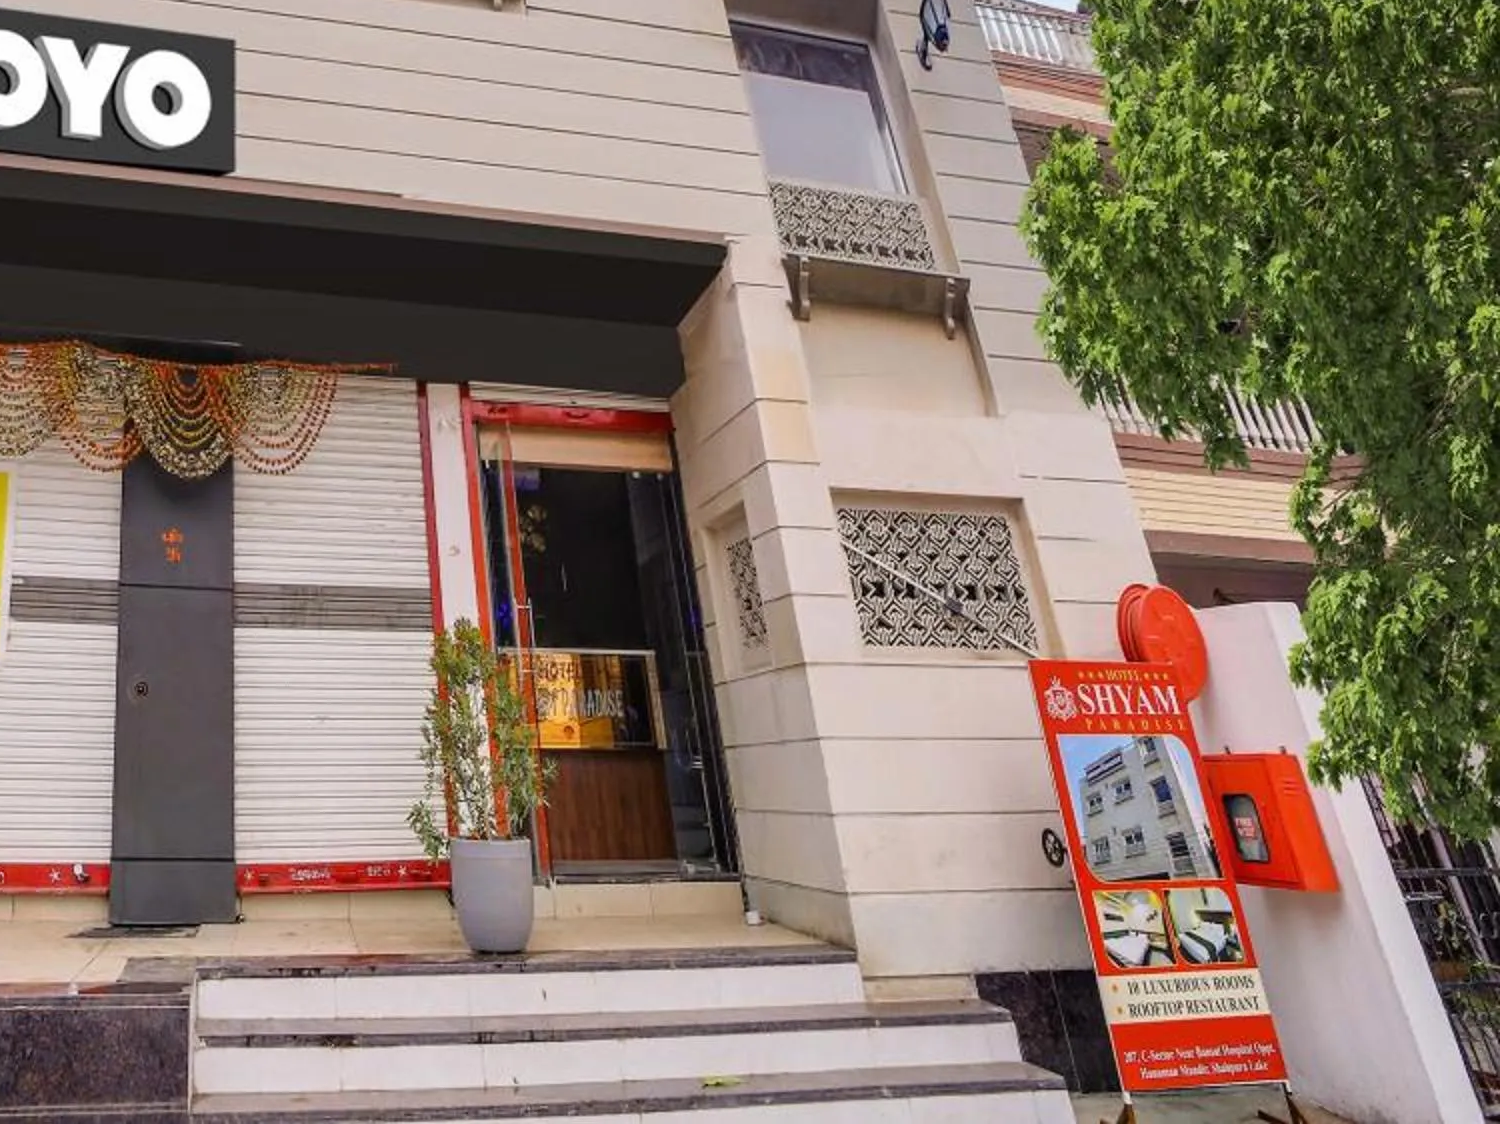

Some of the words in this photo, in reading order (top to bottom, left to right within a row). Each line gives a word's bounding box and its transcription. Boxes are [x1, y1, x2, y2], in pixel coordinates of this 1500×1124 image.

[1106, 669, 1143, 681] HOTEL
[1077, 683, 1182, 716] SHYAM
[1084, 718, 1187, 731] PARADISE
[1143, 978, 1211, 994] LUXURIOUS
[1213, 975, 1255, 991] ROOMS
[1128, 1000, 1183, 1018] ROOFTOP
[1185, 996, 1260, 1015] RESTAURANT
